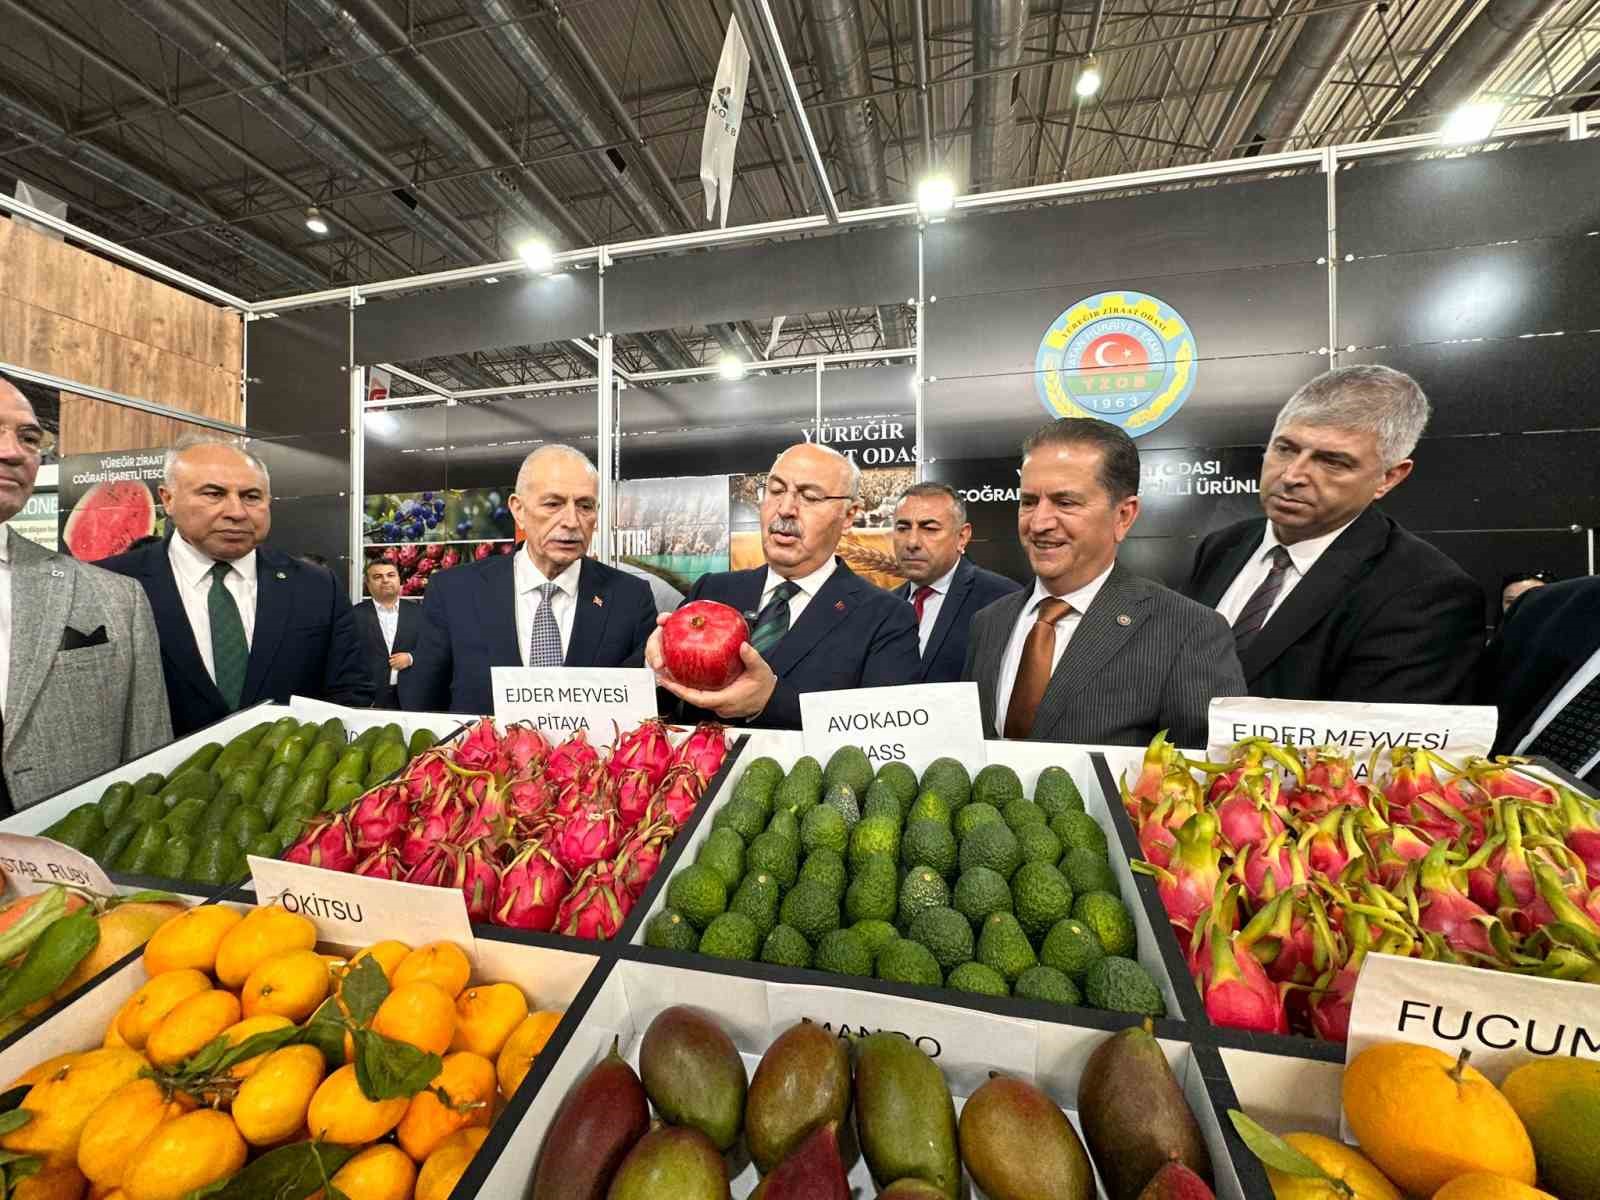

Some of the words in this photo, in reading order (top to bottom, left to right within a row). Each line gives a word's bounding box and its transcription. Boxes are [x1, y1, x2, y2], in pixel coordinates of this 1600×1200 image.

[1093, 397, 1139, 409] 1963
[800, 420, 905, 443] YÜREĞİR
[135, 453, 164, 466] ZİRAAT
[505, 687, 554, 703] EJDER
[558, 685, 629, 703] MEYVESİ
[537, 713, 590, 730] PİTAYA
[827, 708, 929, 733] AVOKADO
[1323, 729, 1449, 750] MEYVESİ
[0, 857, 42, 878] STAR
[47, 863, 91, 885] RUBY
[282, 892, 363, 922] OKİTSU
